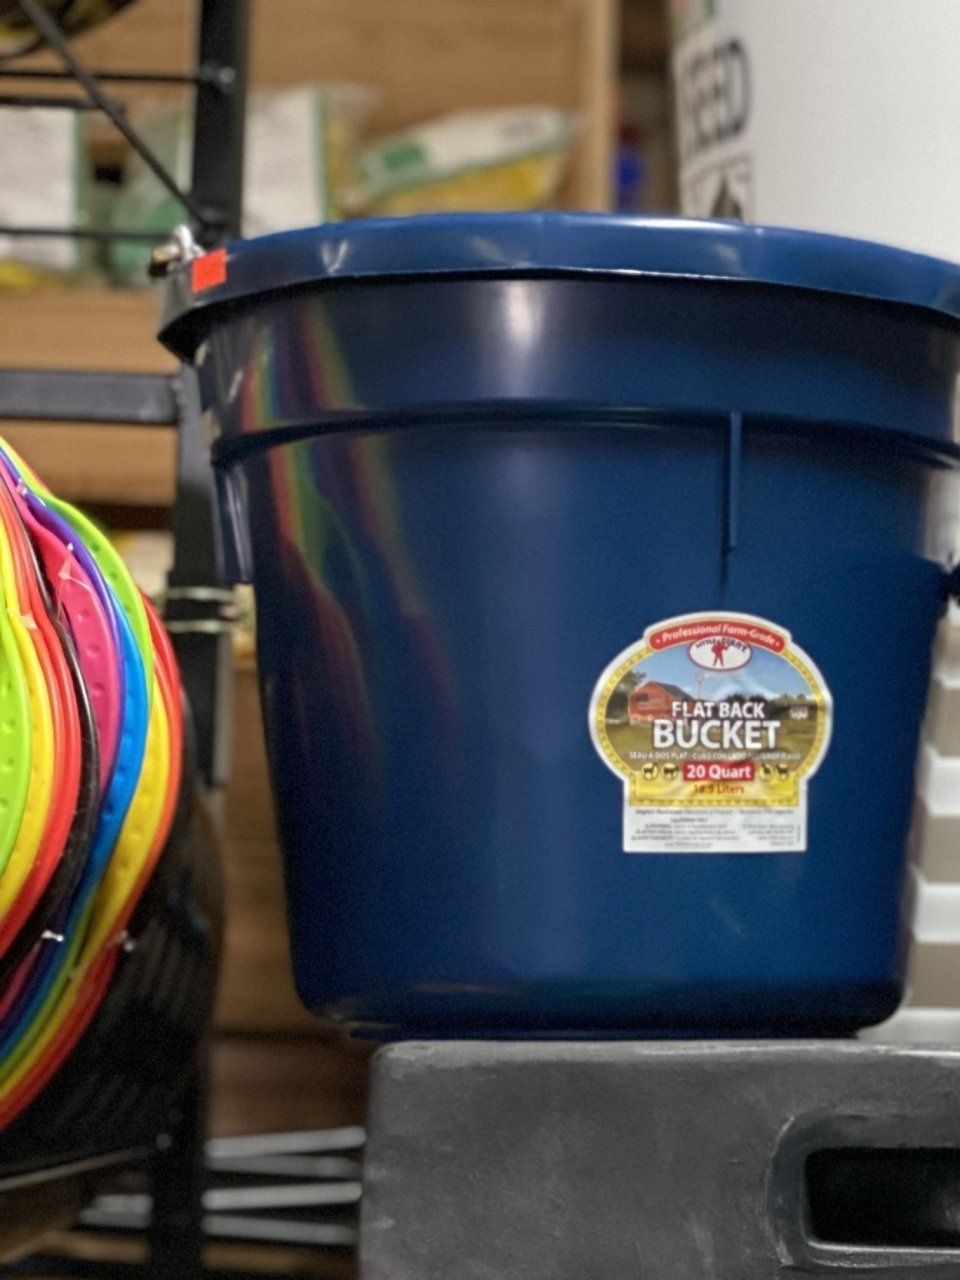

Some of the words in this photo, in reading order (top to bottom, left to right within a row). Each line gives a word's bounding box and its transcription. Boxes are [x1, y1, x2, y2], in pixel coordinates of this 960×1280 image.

[662, 624, 721, 643] Professional
[723, 624, 776, 646] Farm-Grade
[672, 701, 715, 718] FLAT
[719, 702, 766, 719] BACK
[653, 719, 781, 750] BUCKET
[629, 751, 648, 760] SEAU
[655, 752, 671, 760] DOS
[671, 752, 688, 760] PLAT
[727, 753, 747, 761] LADO
[687, 765, 705, 779] 20
[708, 764, 752, 780] Quart
[717, 783, 745, 794] Liters
